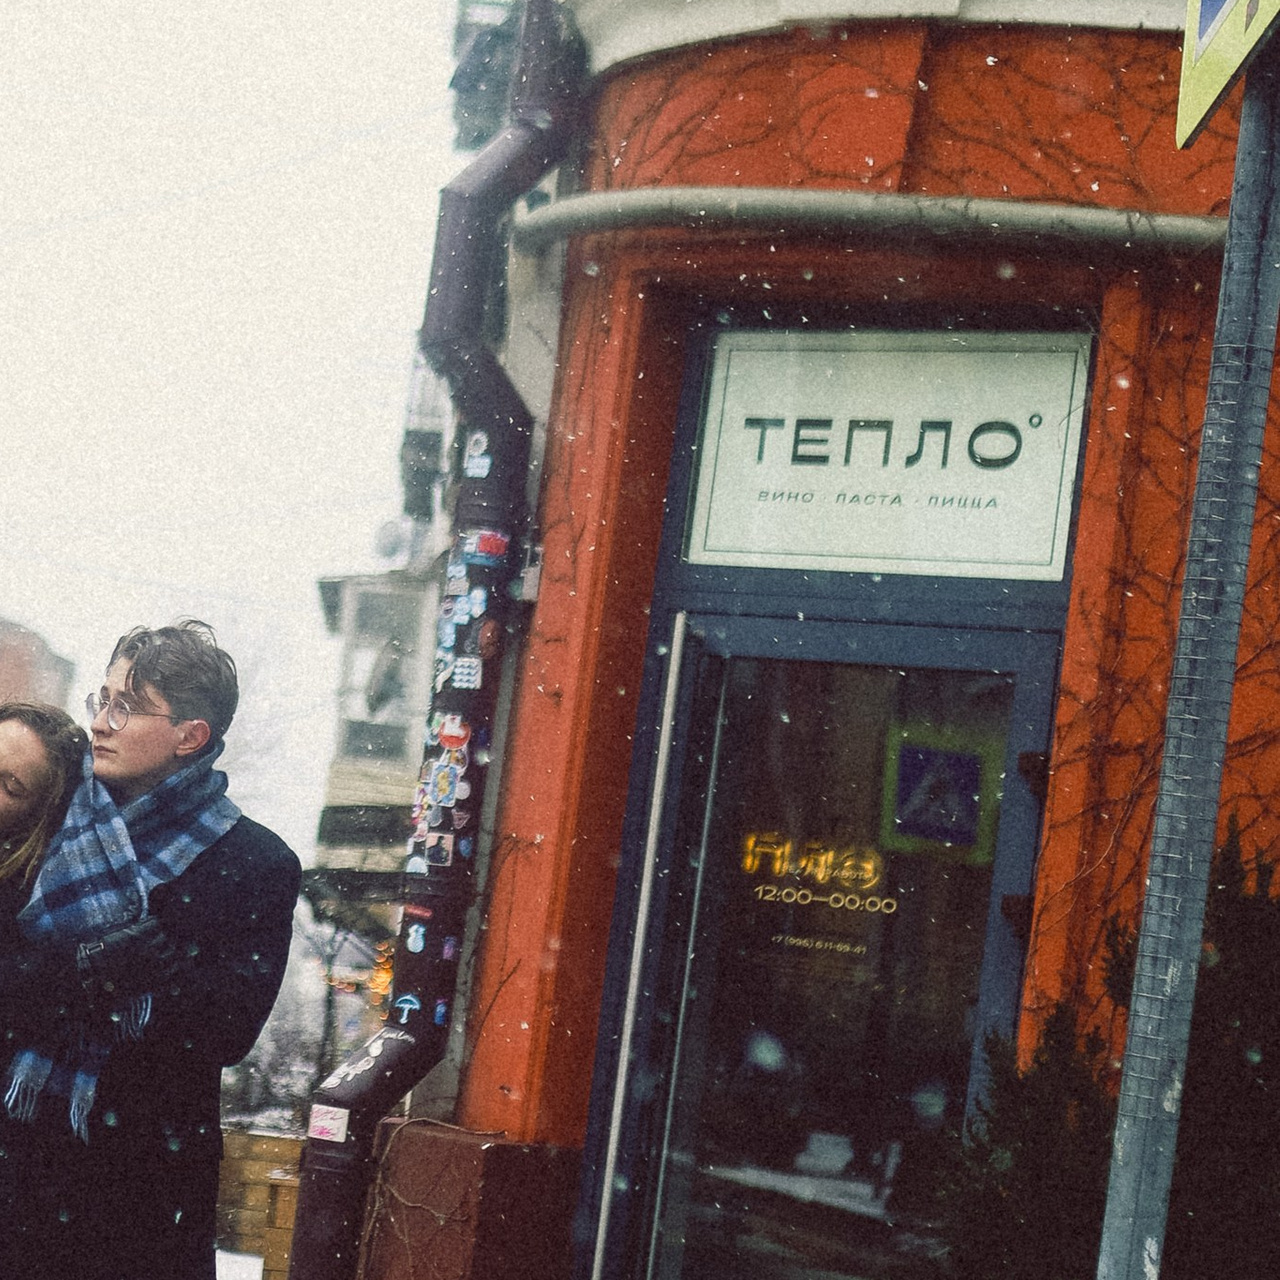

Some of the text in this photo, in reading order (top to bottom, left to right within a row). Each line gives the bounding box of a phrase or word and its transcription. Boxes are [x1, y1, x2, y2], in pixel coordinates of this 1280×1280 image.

[757, 490, 999, 510] ВИНО ПАСТА ПИЦЦА
